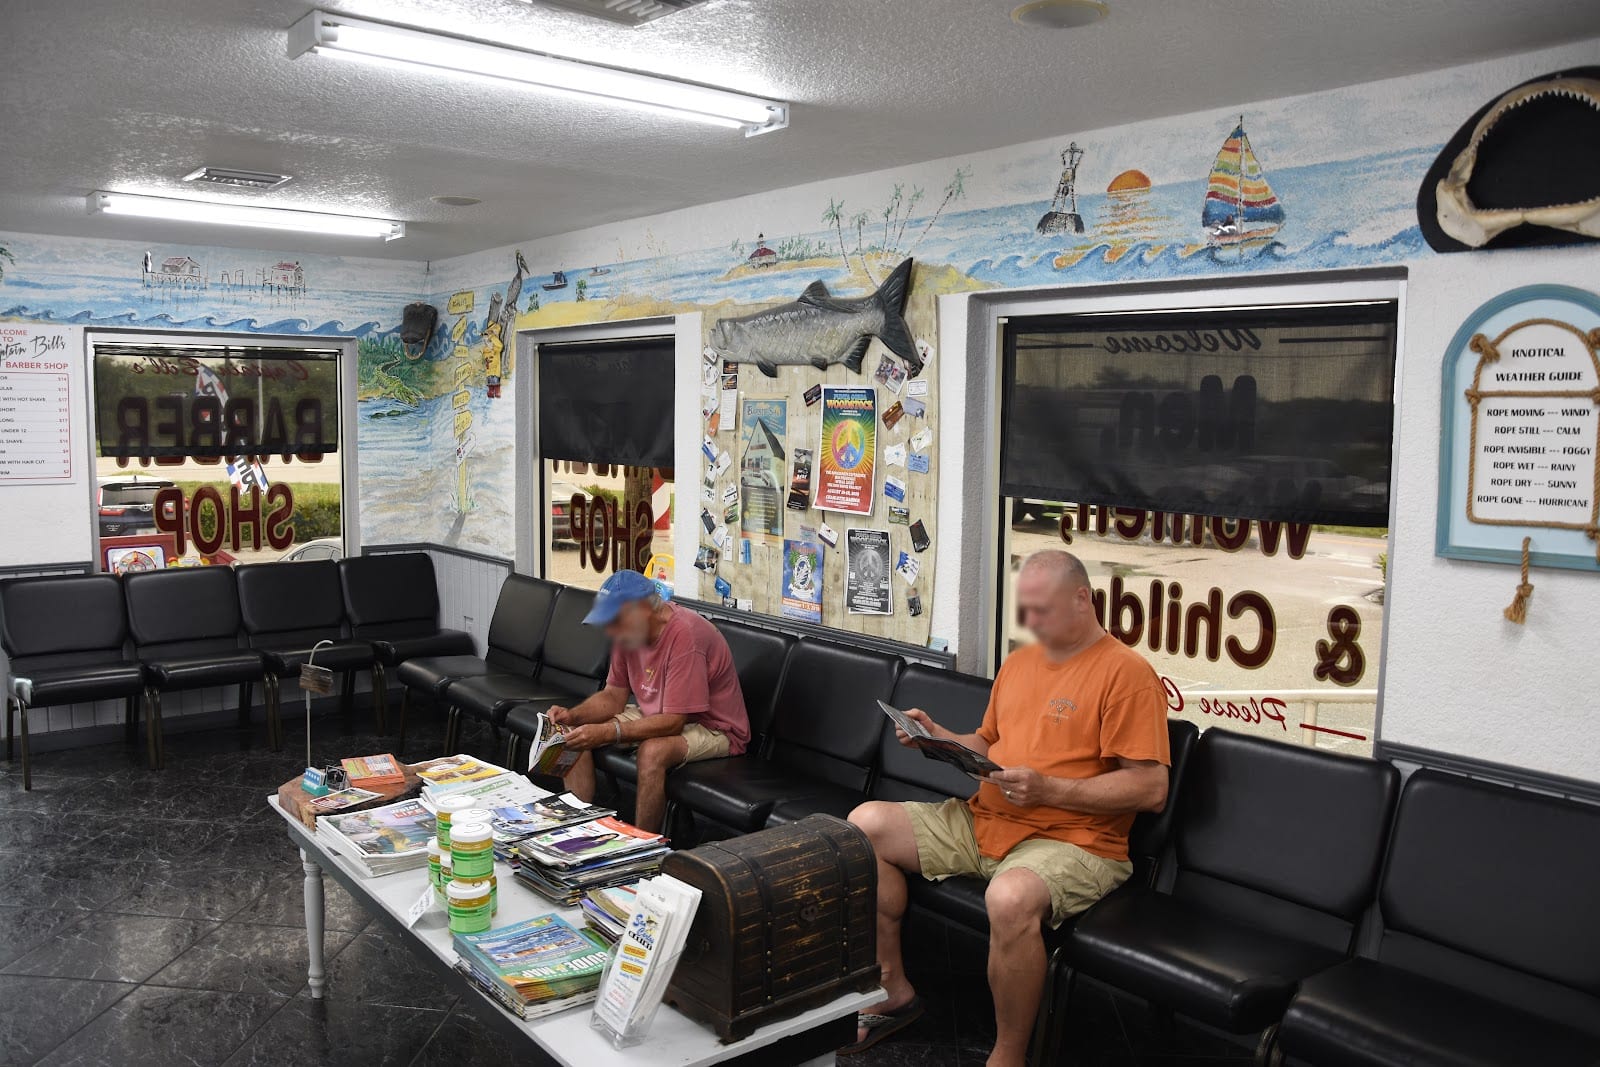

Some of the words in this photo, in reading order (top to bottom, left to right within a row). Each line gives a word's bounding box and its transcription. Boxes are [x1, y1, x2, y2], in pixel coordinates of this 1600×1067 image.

[29, 334, 66, 358] Bill's
[1512, 348, 1566, 358] KNOTICAL
[44, 362, 69, 370] SHOP
[1495, 372, 1545, 382] WEATHER
[1549, 371, 1583, 381] GUIDE
[1486, 408, 1508, 417] ROPE
[1510, 408, 1545, 417] MOVING
[1561, 408, 1591, 417] WINDY
[1494, 426, 1516, 434] ROPE
[1518, 426, 1540, 435] STILL
[1556, 426, 1581, 435] CALM
[1483, 446, 1506, 454] ROPE
[1507, 446, 1546, 454] INVISIBLE
[1562, 447, 1592, 455] FOGGY
[1493, 462, 1516, 470] ROPE
[1517, 462, 1535, 470] WET
[1550, 463, 1576, 472] RAINY
[1490, 478, 1513, 487] ROPE
[1514, 479, 1532, 487] DRY
[1547, 480, 1577, 488] SUNNY
[1477, 495, 1500, 503] ROPE
[1500, 496, 1524, 504] GONE
[1538, 498, 1589, 508] HURRICANE
[563, 951, 609, 971] GUIDE
[521, 966, 557, 978] MAP
